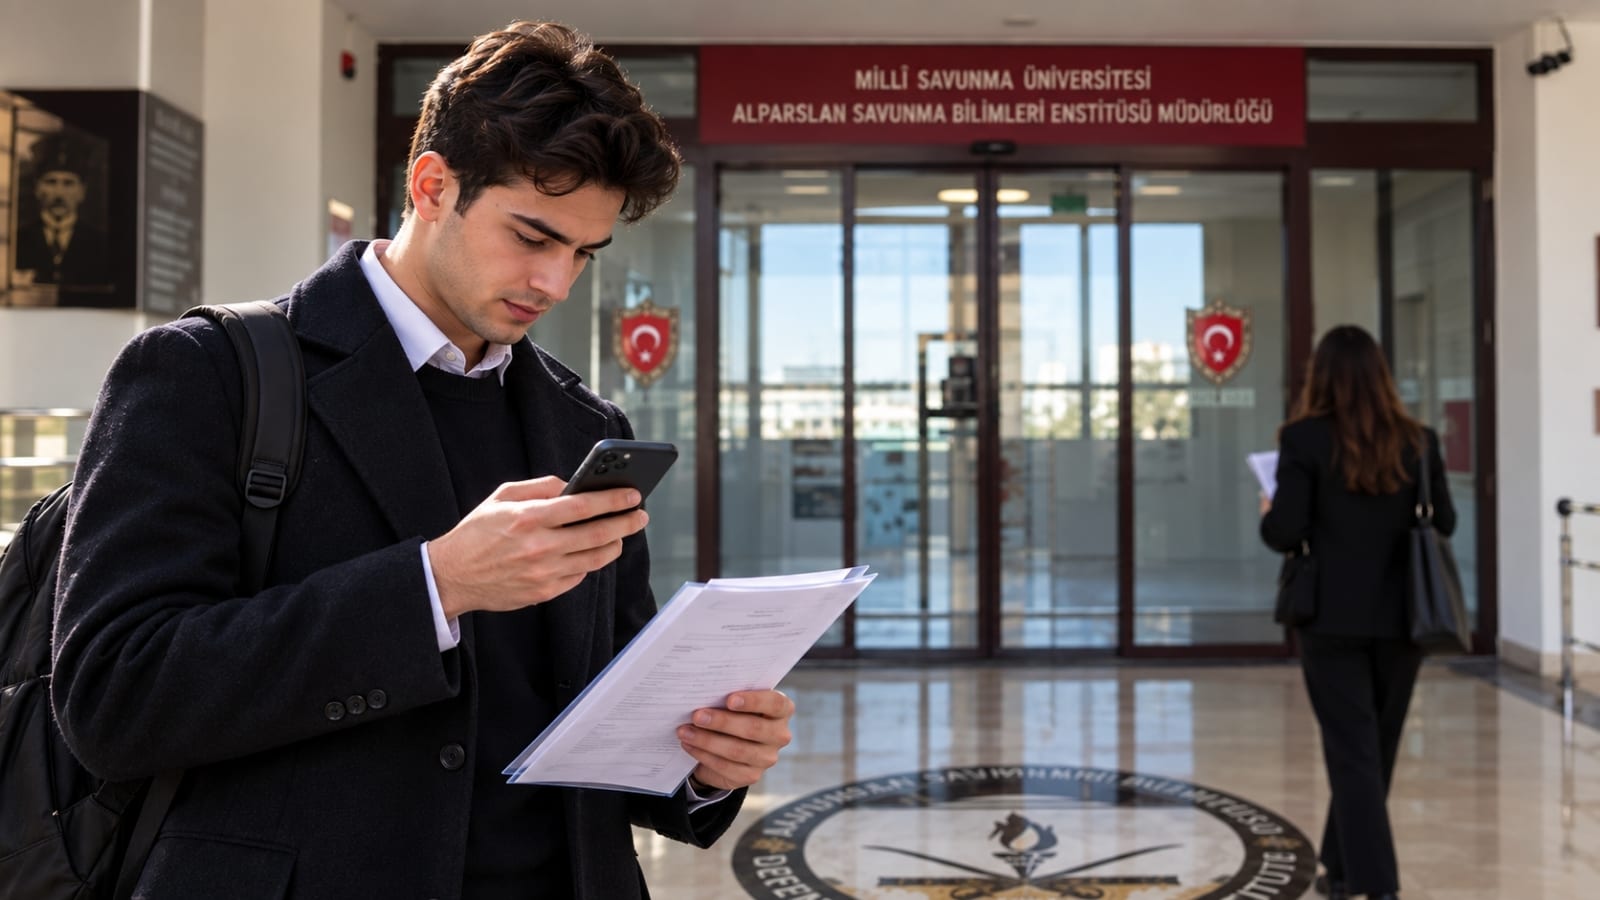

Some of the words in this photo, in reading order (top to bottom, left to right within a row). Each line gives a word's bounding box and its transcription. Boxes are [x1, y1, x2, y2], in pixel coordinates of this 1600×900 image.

[917, 69, 1015, 90] SAVUNMA
[1023, 65, 1152, 90] ÜNİVERSİTESİ
[732, 102, 847, 124] ALPARSLAN
[852, 102, 947, 124] SAVUNMA
[951, 99, 1045, 124] BİLİMLERİ
[1050, 99, 1153, 124] ENSTİTÜSÜ
[1157, 98, 1274, 124] MÜDÜRLÜĞÜ
